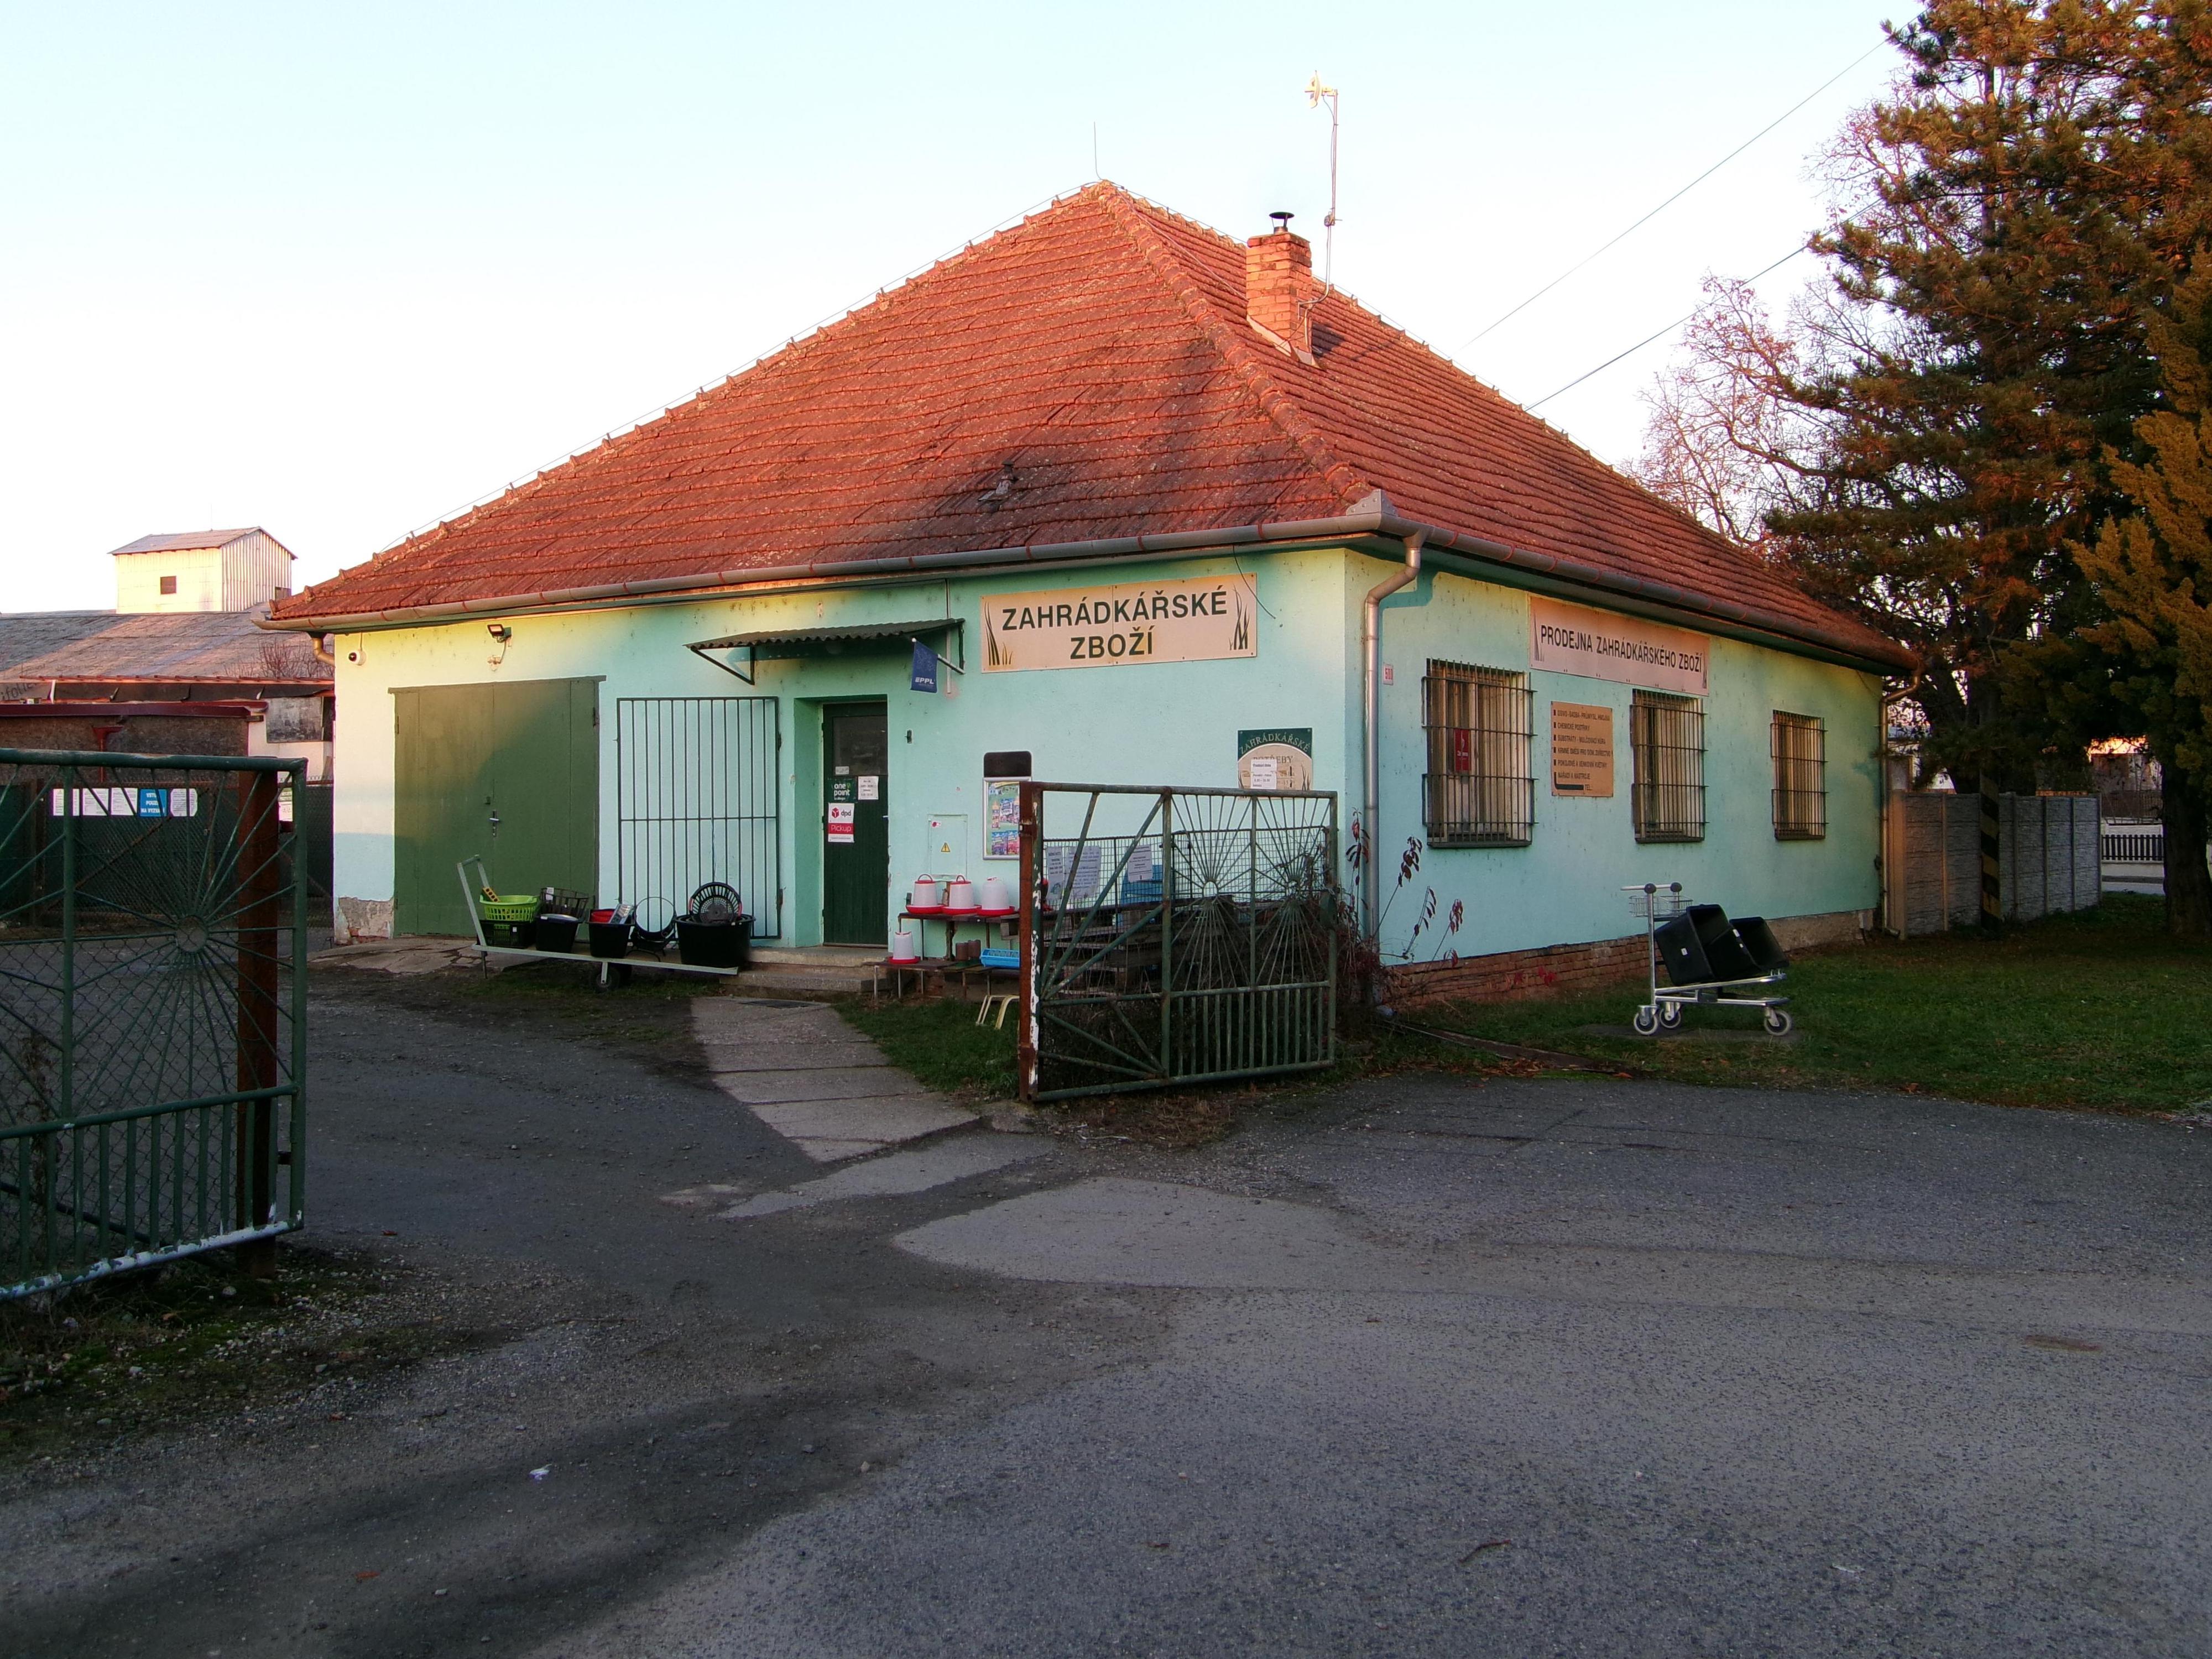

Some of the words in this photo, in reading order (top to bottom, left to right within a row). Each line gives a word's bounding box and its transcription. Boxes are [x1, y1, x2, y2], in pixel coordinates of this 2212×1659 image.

[1001, 585, 1227, 631] ZAHRÁDKÁŘSKÉ
[1070, 625, 1154, 660] ZBOŽÍ
[1540, 624, 1593, 653] PRODEJNA
[1596, 635, 1676, 669] ZAHRÁDKÁŘSKÉHO
[1678, 650, 1703, 673] ZBOŽÍ
[1240, 733, 1310, 754] ZAHRÁDKÁŘSKÉ
